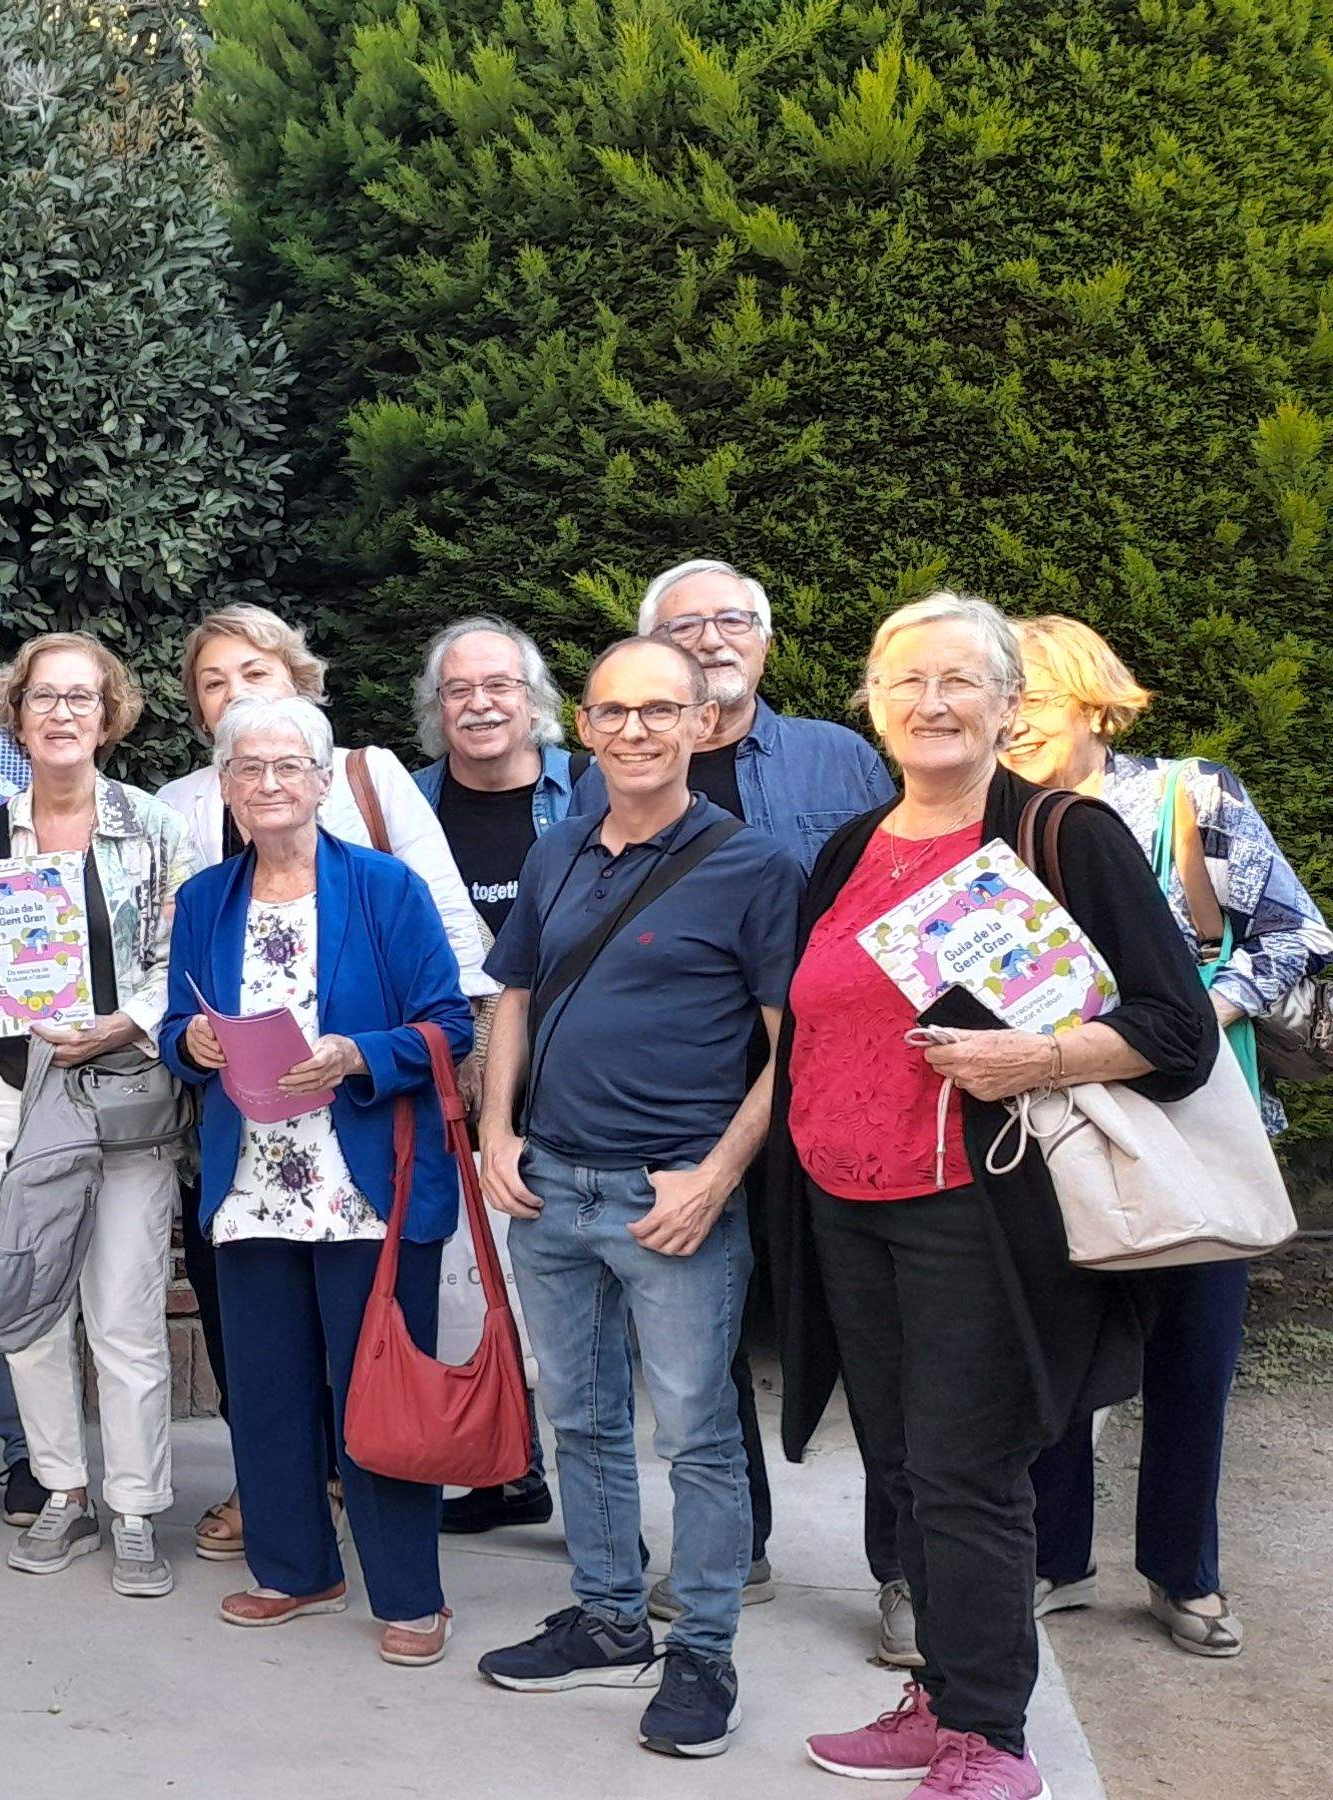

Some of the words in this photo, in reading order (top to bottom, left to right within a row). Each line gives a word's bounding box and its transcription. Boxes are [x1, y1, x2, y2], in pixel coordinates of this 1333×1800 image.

[943, 940, 974, 963] Guia
[973, 928, 989, 944] de
[988, 920, 1002, 933] la
[952, 951, 985, 974] Gent
[982, 931, 1014, 954] Gran
